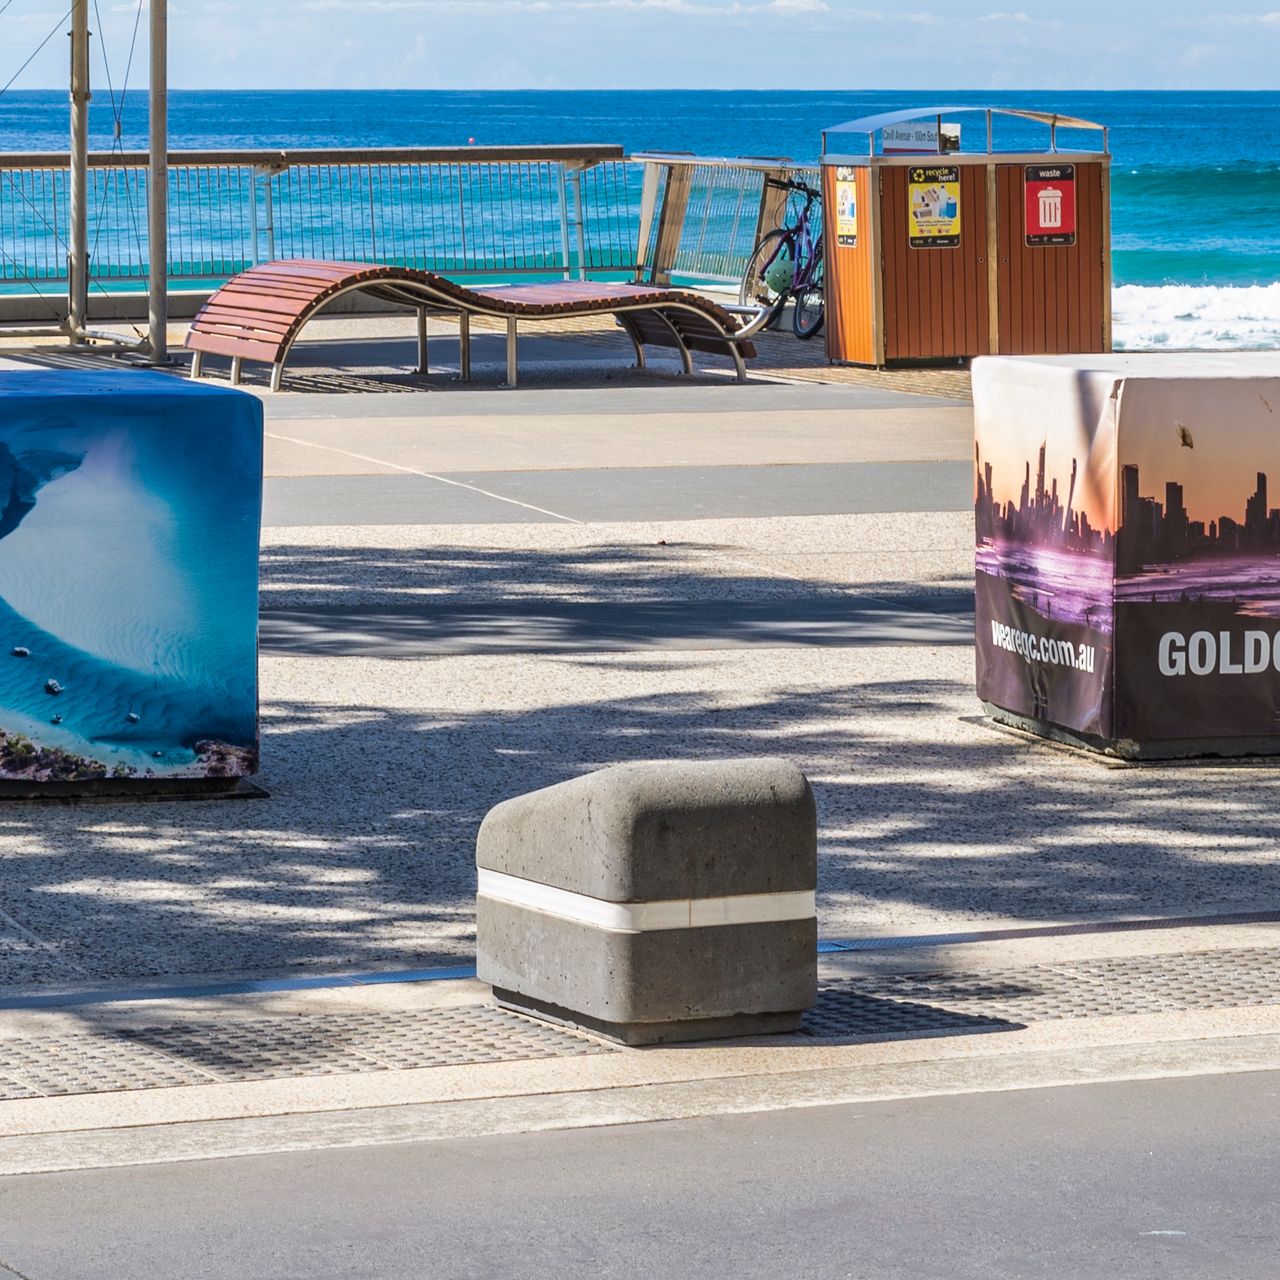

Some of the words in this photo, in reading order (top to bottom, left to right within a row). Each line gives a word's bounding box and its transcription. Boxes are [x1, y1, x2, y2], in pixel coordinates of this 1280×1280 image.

[925, 168, 949, 177] recycle
[938, 173, 956, 181] here!
[1039, 169, 1061, 178] waste
[991, 619, 1095, 674] wearegc.com.au
